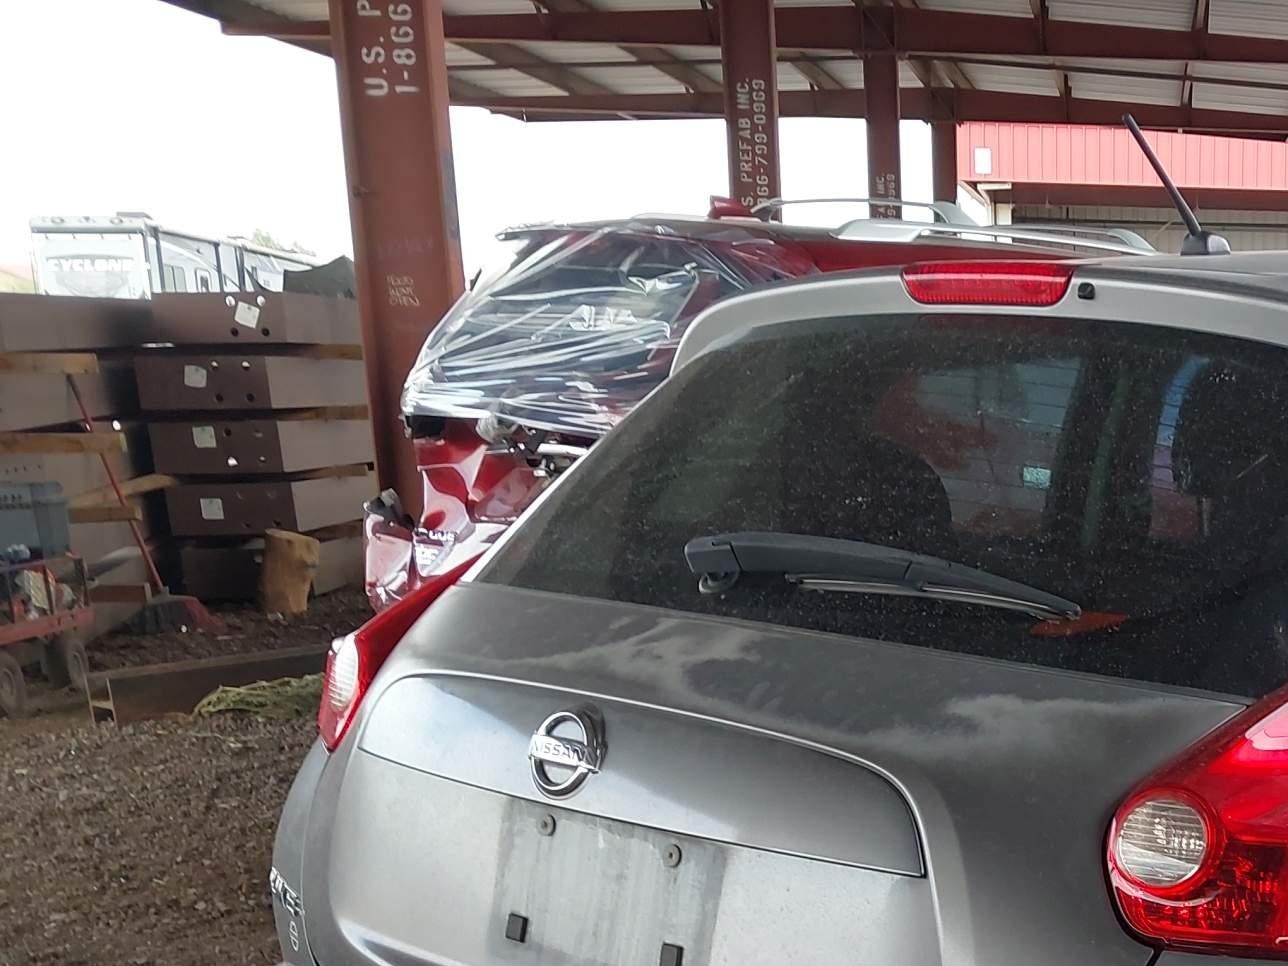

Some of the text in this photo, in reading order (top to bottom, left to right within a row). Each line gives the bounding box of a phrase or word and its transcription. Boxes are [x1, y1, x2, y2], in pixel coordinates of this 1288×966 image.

[360, 35, 389, 96] U.S.
[388, 3, 420, 94] 1-866
[736, 78, 750, 110] INC.
[738, 117, 752, 182] PREFAB
[531, 737, 597, 768] NISSAN
